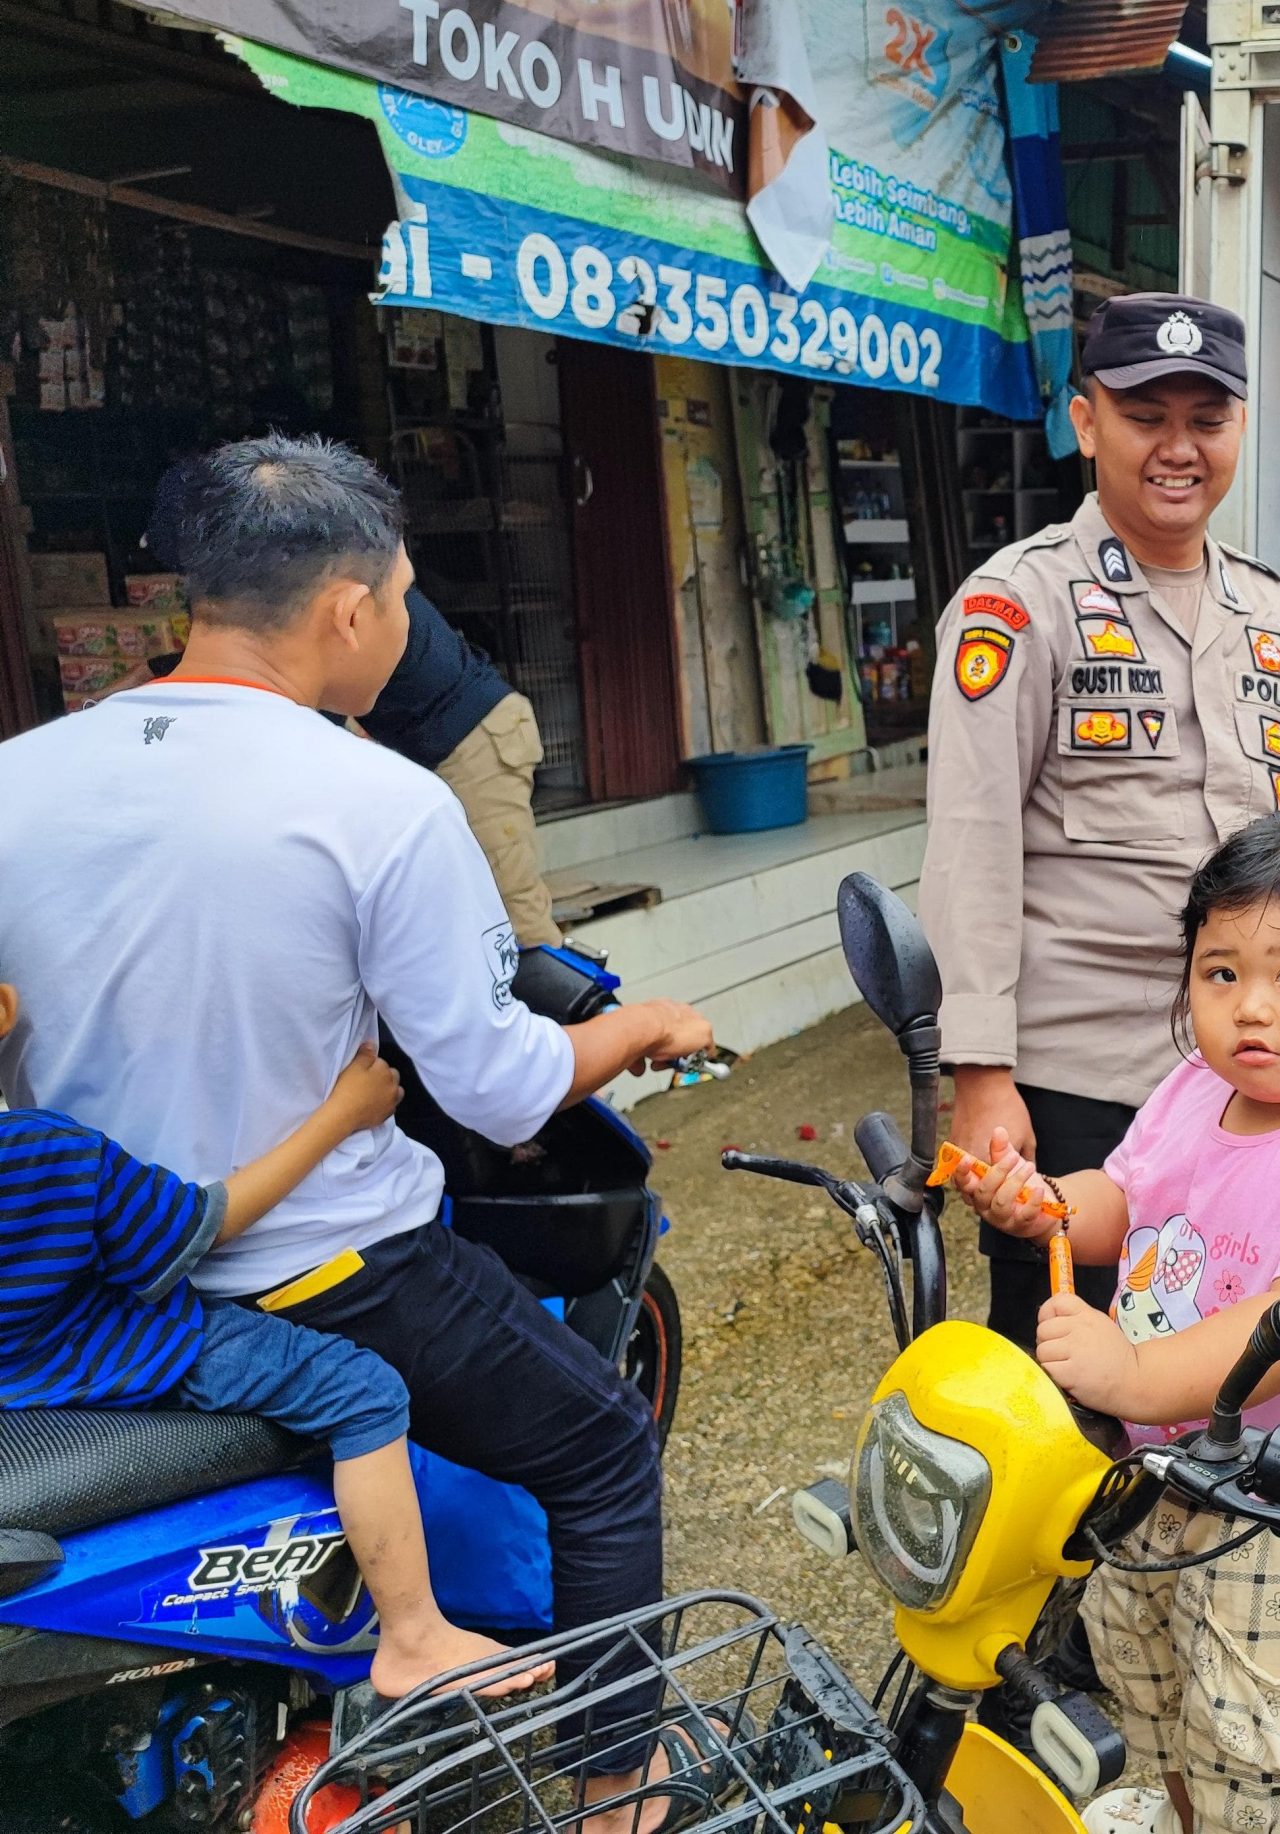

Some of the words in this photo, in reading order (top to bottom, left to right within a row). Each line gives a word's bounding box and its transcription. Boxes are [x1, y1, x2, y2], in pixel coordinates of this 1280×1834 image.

[400, 0, 562, 109] TOKO
[577, 58, 626, 129] H
[642, 75, 735, 174] UDIN
[831, 155, 883, 199] Lebih
[886, 176, 972, 235] Seimbang,
[834, 193, 886, 234] Lebih
[887, 213, 937, 251] Aman
[516, 232, 943, 389] 082350329002
[1072, 666, 1122, 694] GUSTI
[1209, 1231, 1261, 1266] girls
[105, 1657, 196, 1685] HONDA
